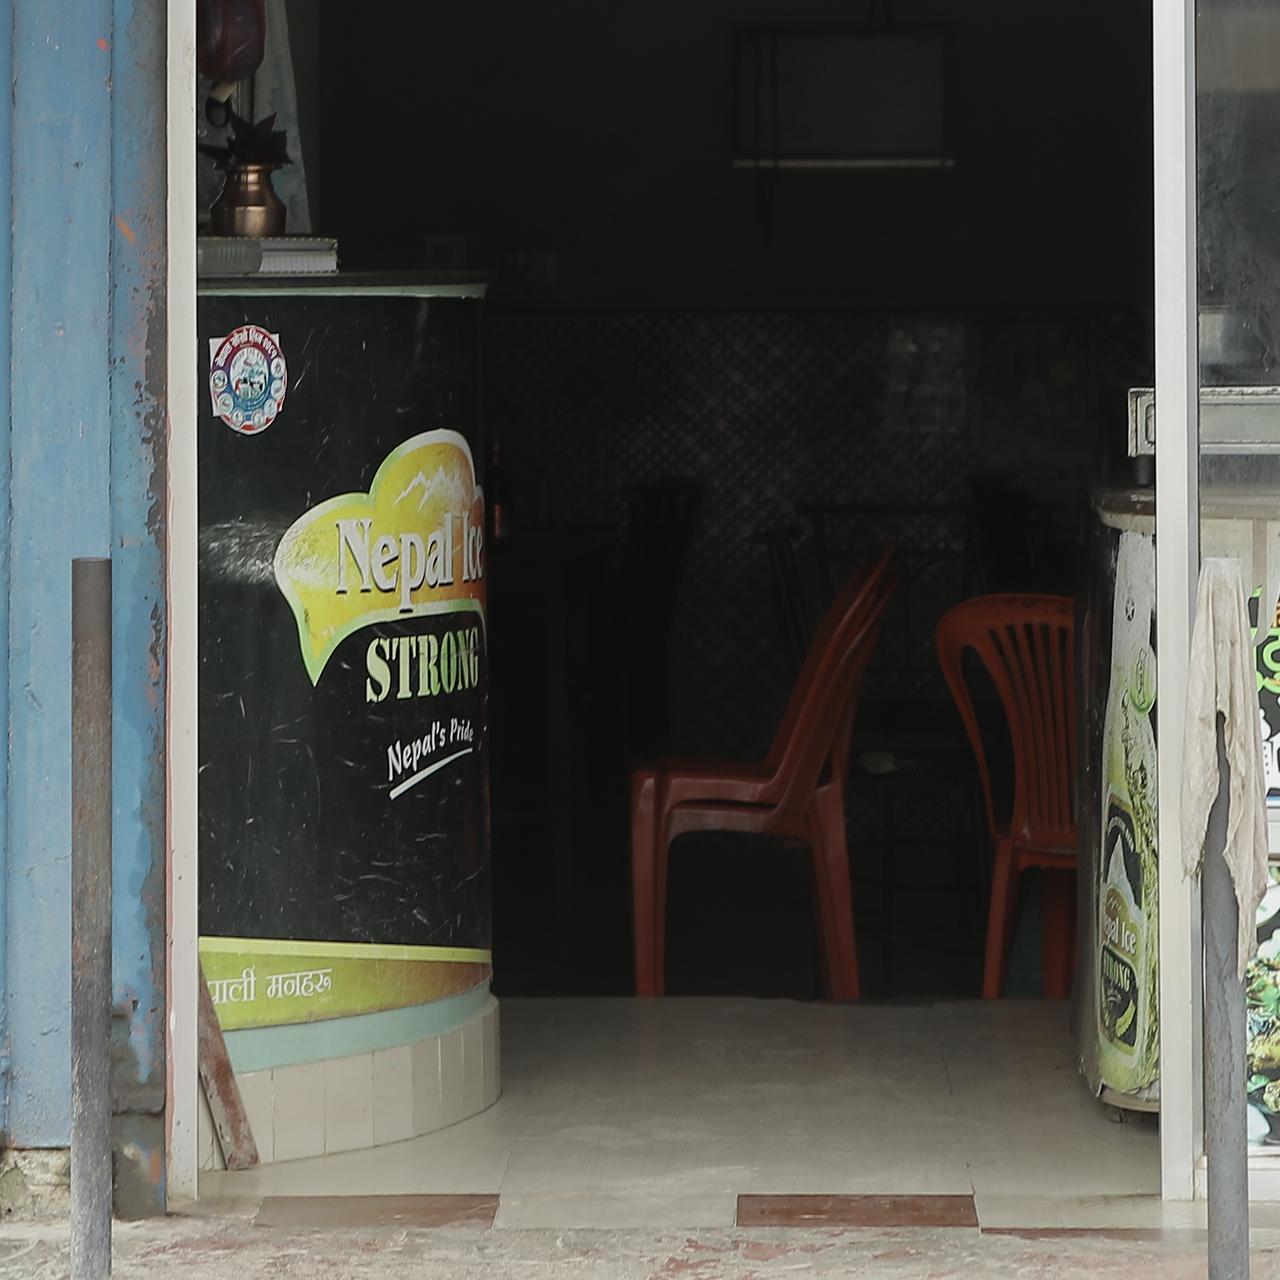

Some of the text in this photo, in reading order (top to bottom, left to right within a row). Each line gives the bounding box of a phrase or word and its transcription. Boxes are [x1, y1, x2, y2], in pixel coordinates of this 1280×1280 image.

[336, 511, 454, 613] Nepal
[366, 626, 480, 704] STRONG
[387, 717, 475, 783] Nepal's Pride
